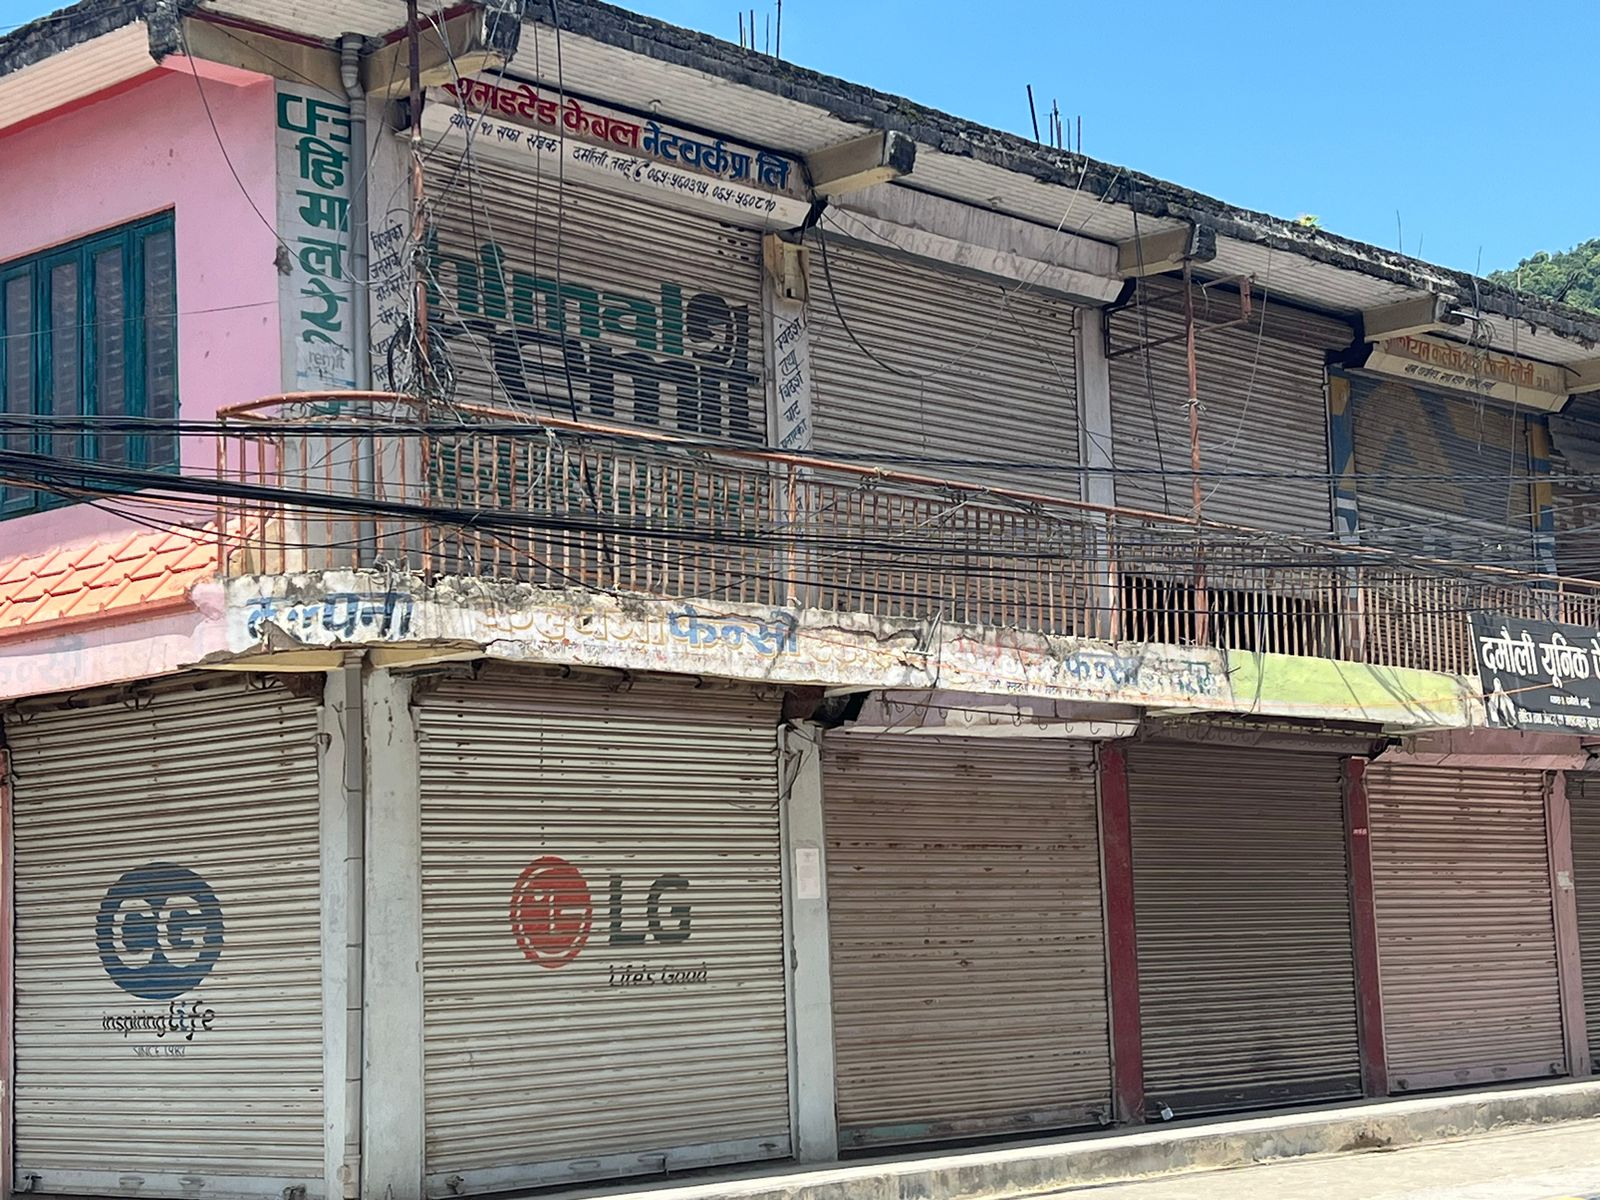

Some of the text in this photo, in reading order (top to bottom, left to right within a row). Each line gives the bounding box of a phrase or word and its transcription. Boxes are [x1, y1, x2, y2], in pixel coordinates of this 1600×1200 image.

[563, 98, 640, 149] केबल
[642, 121, 729, 174] नेटवर्क
[112, 894, 208, 970] CG
[608, 872, 692, 946] LG
